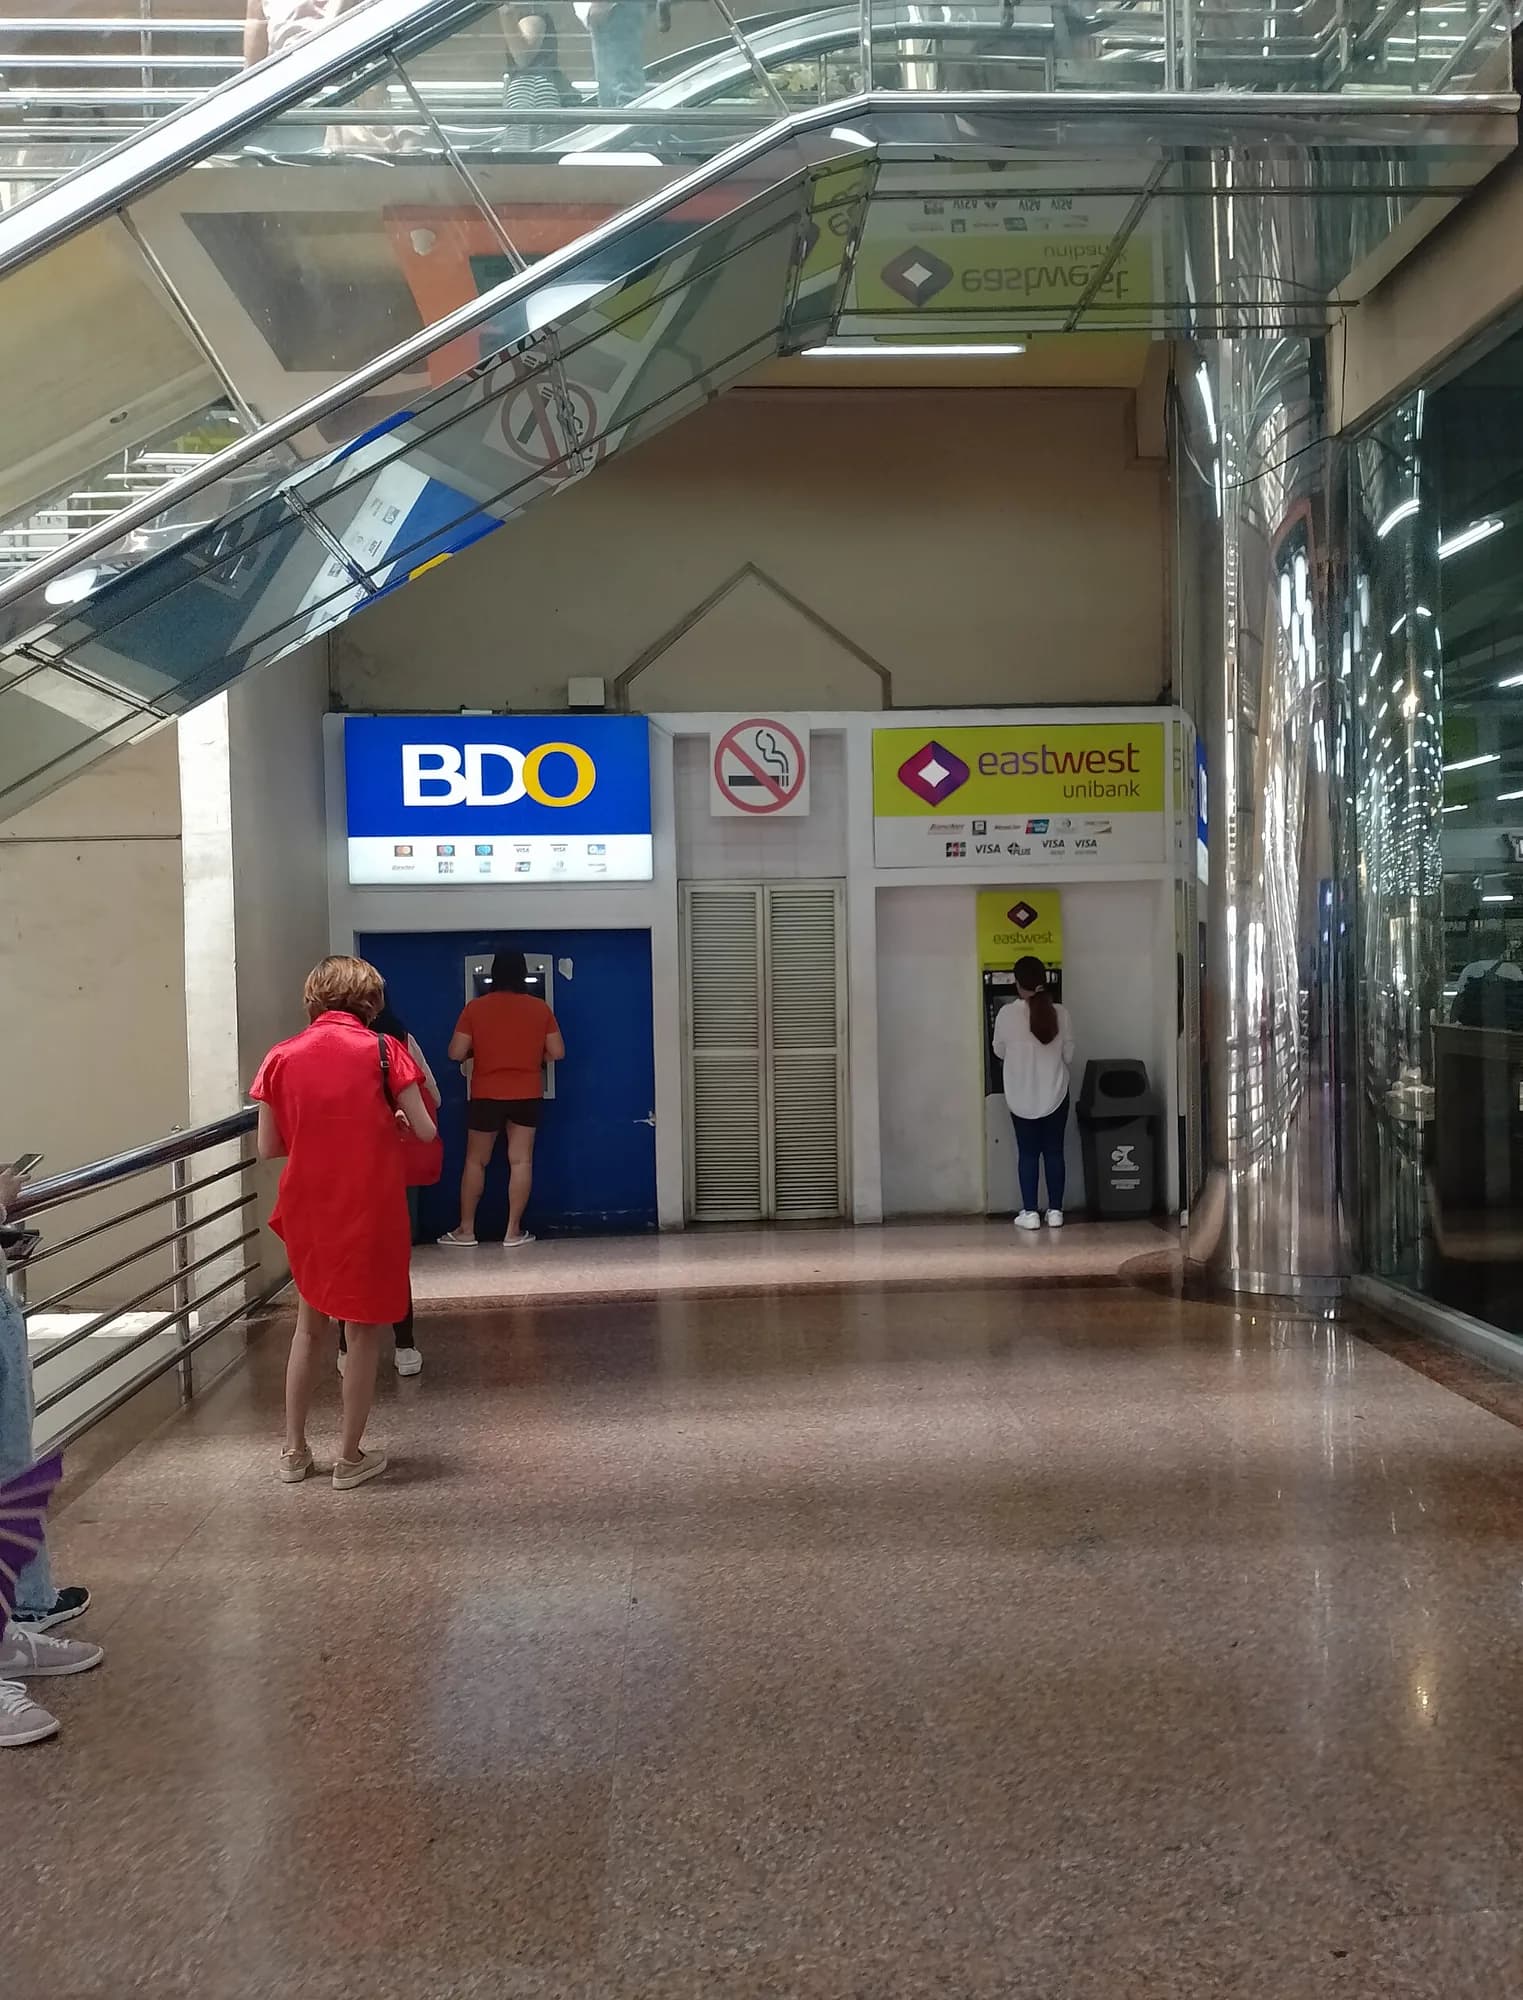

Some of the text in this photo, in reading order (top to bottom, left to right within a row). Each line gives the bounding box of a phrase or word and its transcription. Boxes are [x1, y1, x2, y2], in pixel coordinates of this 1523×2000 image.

[978, 742, 1140, 776] eastwest
[402, 742, 597, 807] BDO
[1063, 780, 1140, 798] unibank
[975, 843, 1001, 854] VISA
[1042, 839, 1065, 848] VISA
[1075, 839, 1098, 848] VISA
[993, 931, 1054, 945] eastwest
